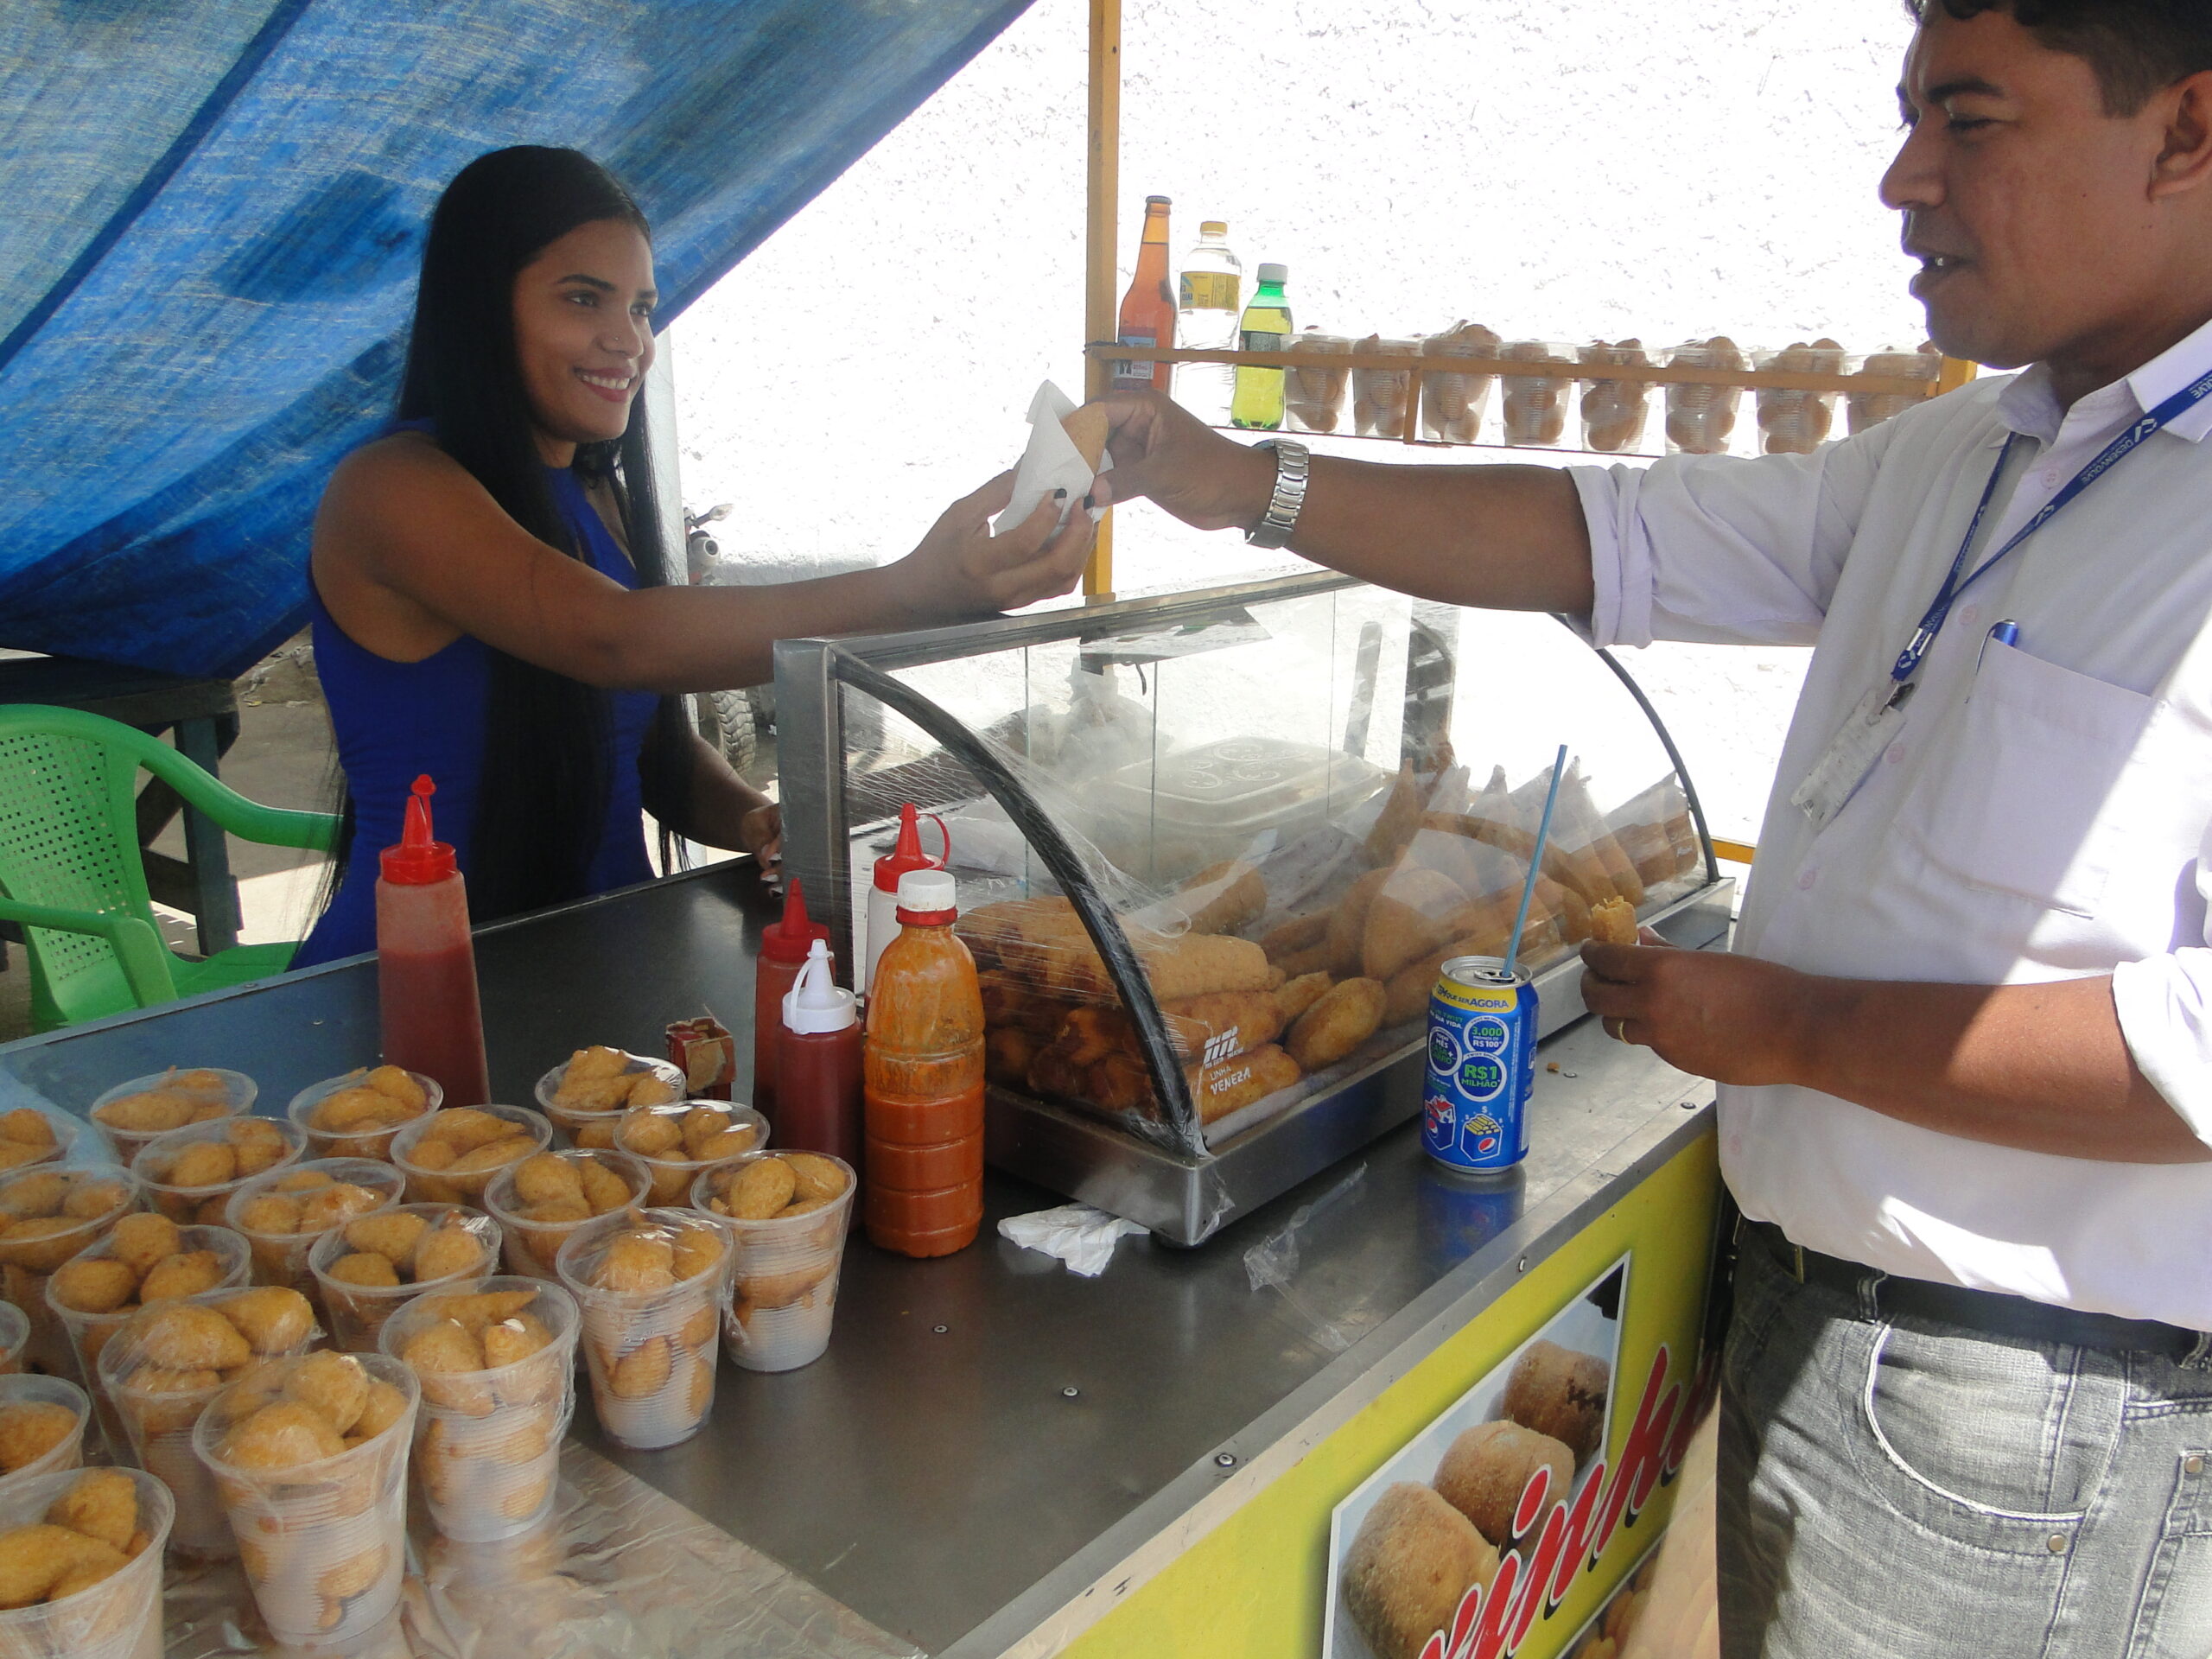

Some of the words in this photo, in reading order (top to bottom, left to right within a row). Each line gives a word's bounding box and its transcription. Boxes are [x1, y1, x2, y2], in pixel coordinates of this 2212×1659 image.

[2081, 439, 2134, 483] DESENVOLVE
[1469, 998, 1510, 1008] AGORA
[1471, 1027, 1503, 1036] 3.000
[1210, 1065, 1232, 1081] LINHA
[1211, 1066, 1251, 1095] VENEZA
